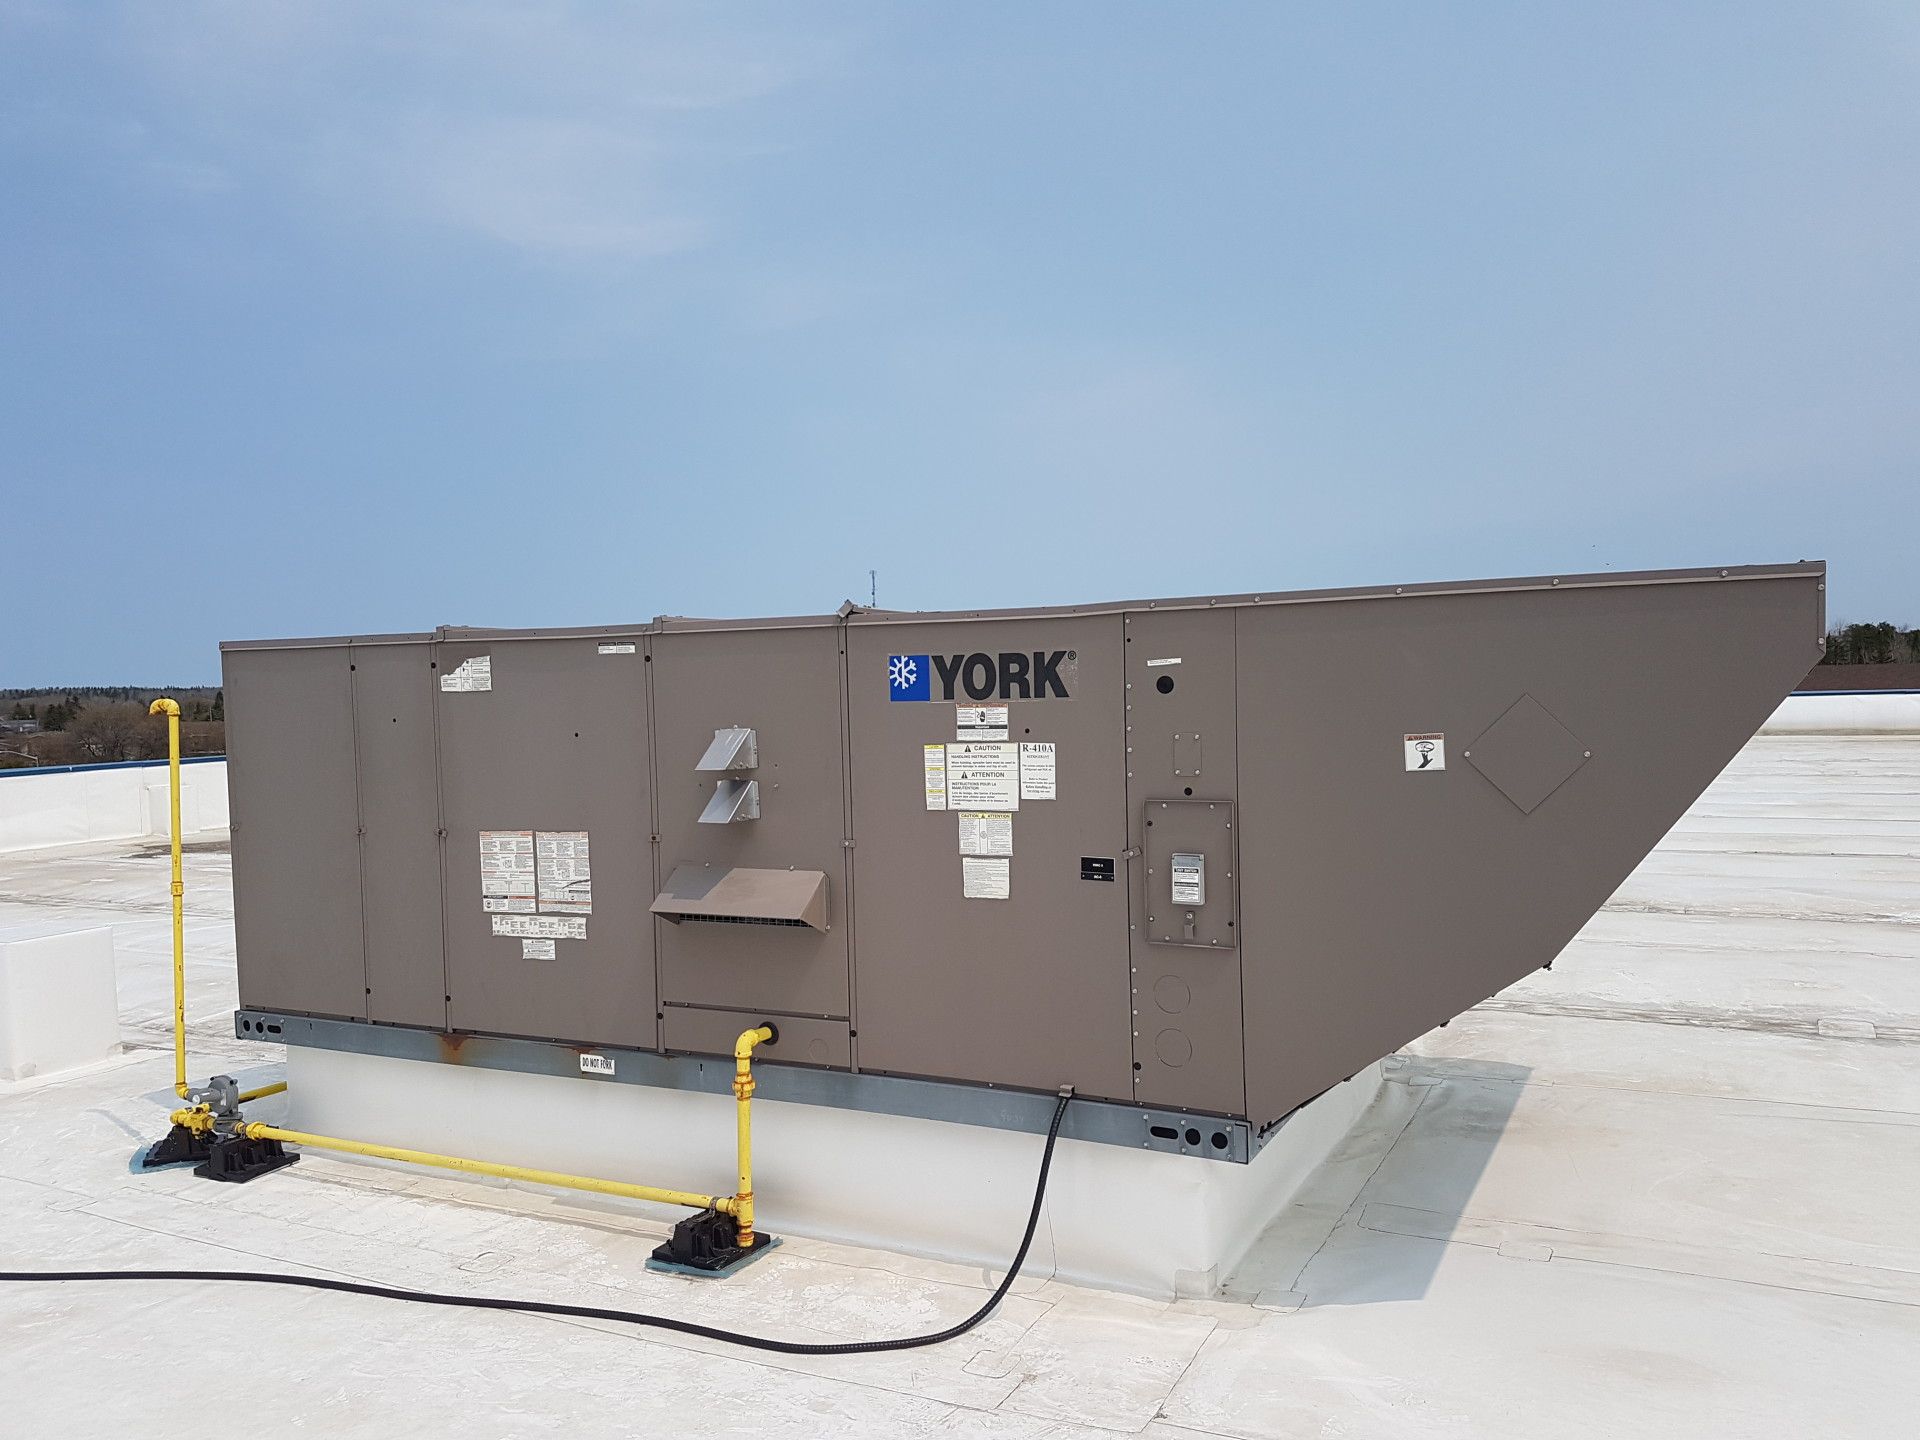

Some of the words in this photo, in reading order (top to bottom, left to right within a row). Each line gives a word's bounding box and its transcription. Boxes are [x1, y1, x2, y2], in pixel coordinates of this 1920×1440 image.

[932, 651, 1069, 700] YORK
[1022, 743, 1054, 753] R-410A
[582, 1057, 589, 1067] DO
[590, 1058, 599, 1068] NOT
